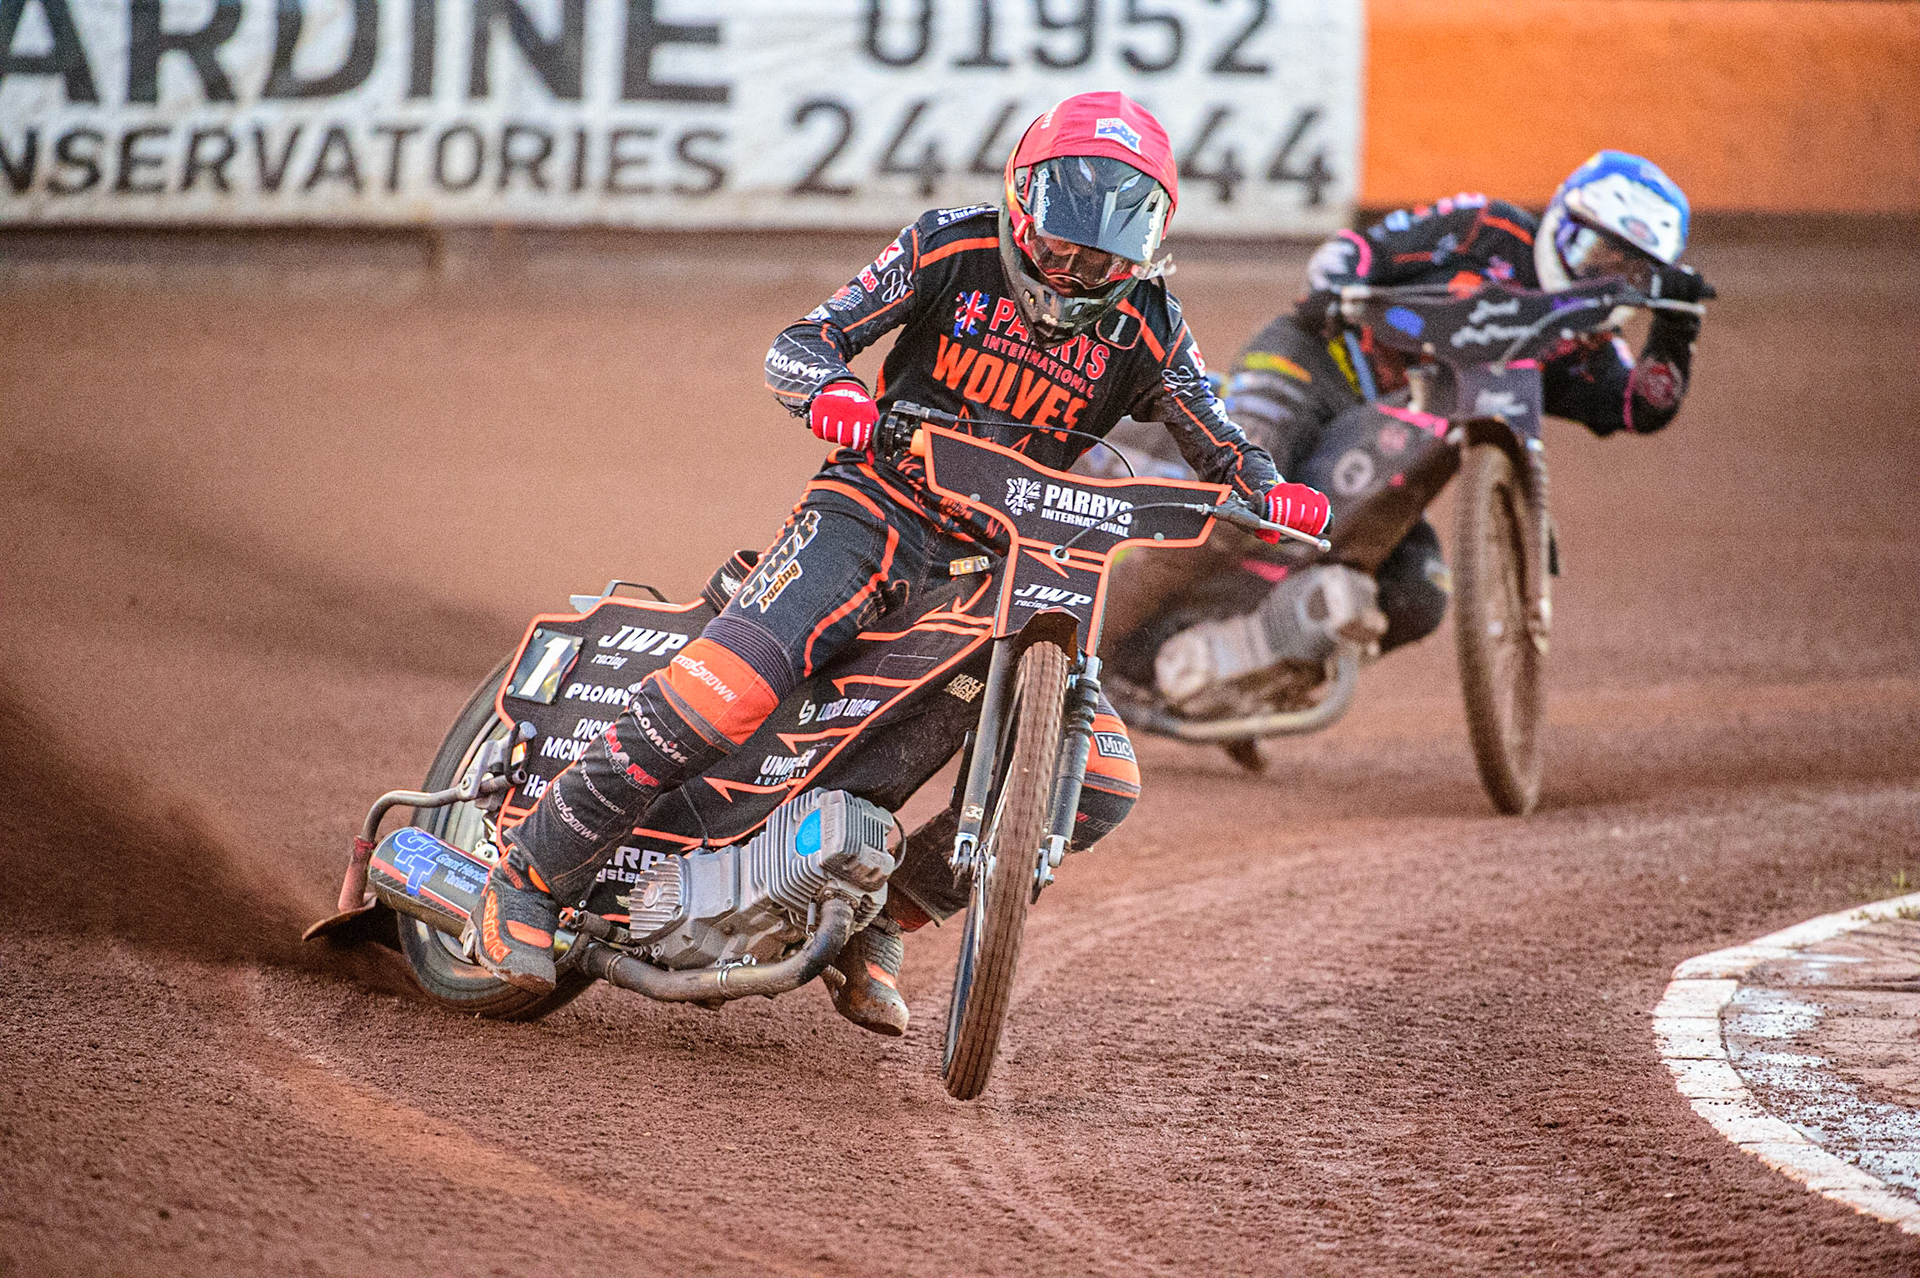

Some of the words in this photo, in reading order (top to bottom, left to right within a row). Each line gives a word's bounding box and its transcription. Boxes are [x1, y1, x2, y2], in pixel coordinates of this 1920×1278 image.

[866, 0, 1272, 73] 01952
[990, 297, 1110, 380] PARYS
[1108, 314, 1129, 343] 1
[932, 333, 1088, 442] WOLVES
[1041, 508, 1130, 538] INTERNATONAL
[1043, 484, 1134, 525] PARRYS
[756, 559, 803, 614] racing
[1013, 583, 1093, 607] JWP
[598, 625, 689, 656] JWP
[519, 637, 572, 697] 1
[590, 653, 628, 670] racing
